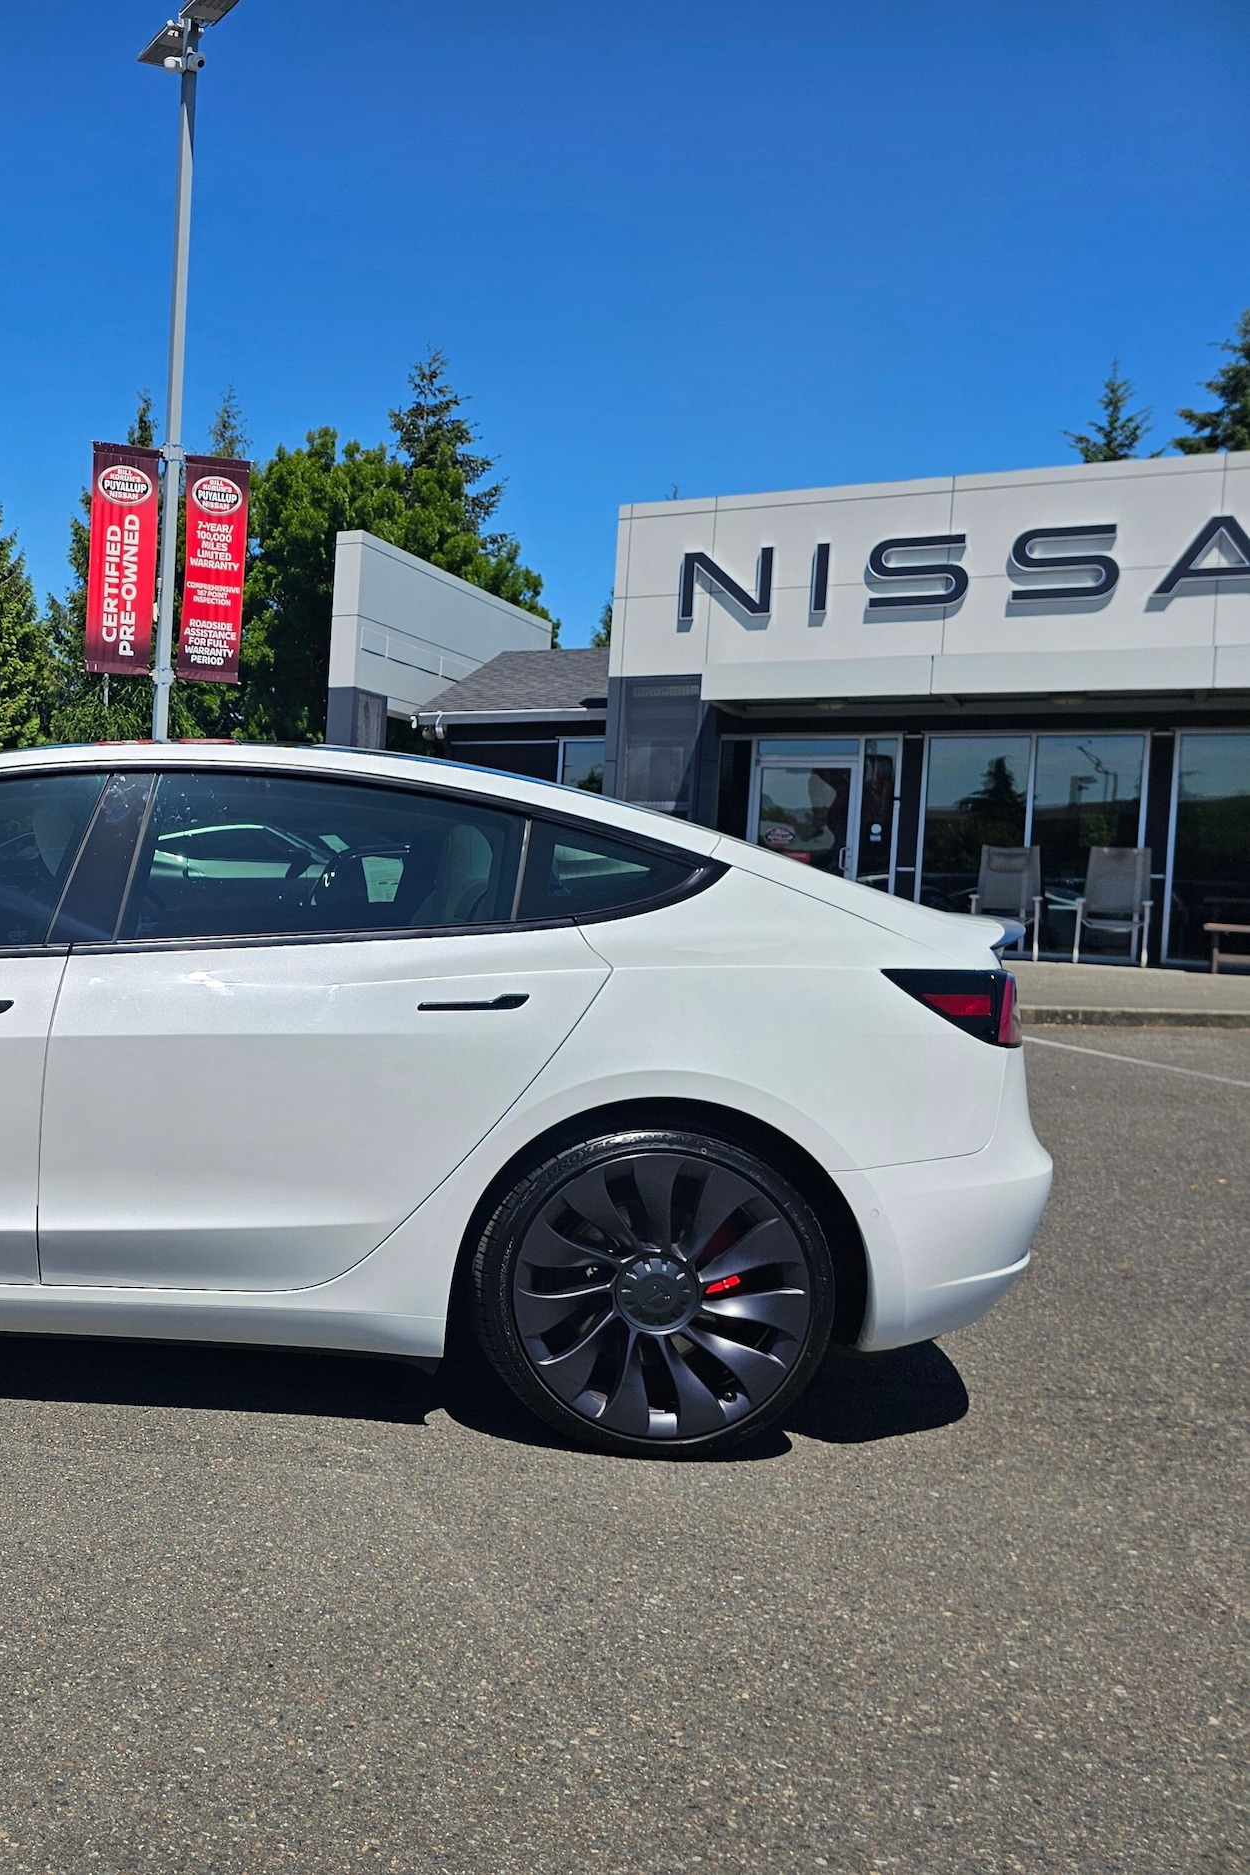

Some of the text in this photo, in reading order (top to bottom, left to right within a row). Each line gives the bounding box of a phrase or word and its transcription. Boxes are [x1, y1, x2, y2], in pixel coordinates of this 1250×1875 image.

[104, 480, 147, 493] PUYALLUP
[109, 490, 138, 500] NISSAN
[197, 489, 237, 503] PUYALLUP
[202, 500, 230, 510] NISSAN
[197, 521, 234, 534] 7-YEAR/
[196, 530, 232, 543] 100,000
[201, 540, 228, 551] MILES
[197, 548, 232, 561] LIMITED
[189, 556, 239, 572] WARRANTY
[102, 525, 121, 643] CERTIFIED
[118, 514, 141, 657] PRE-OWNED
[186, 581, 240, 594] COMPREHENSIVE
[193, 595, 231, 607] INSPECTION
[207, 591, 228, 599] POINT
[189, 618, 233, 631] ROADSIDE
[184, 627, 237, 640] ASSISTANCE
[188, 636, 229, 649] FOR FULL
[184, 644, 234, 658] WARRANTY
[190, 654, 224, 666] PERIOD
